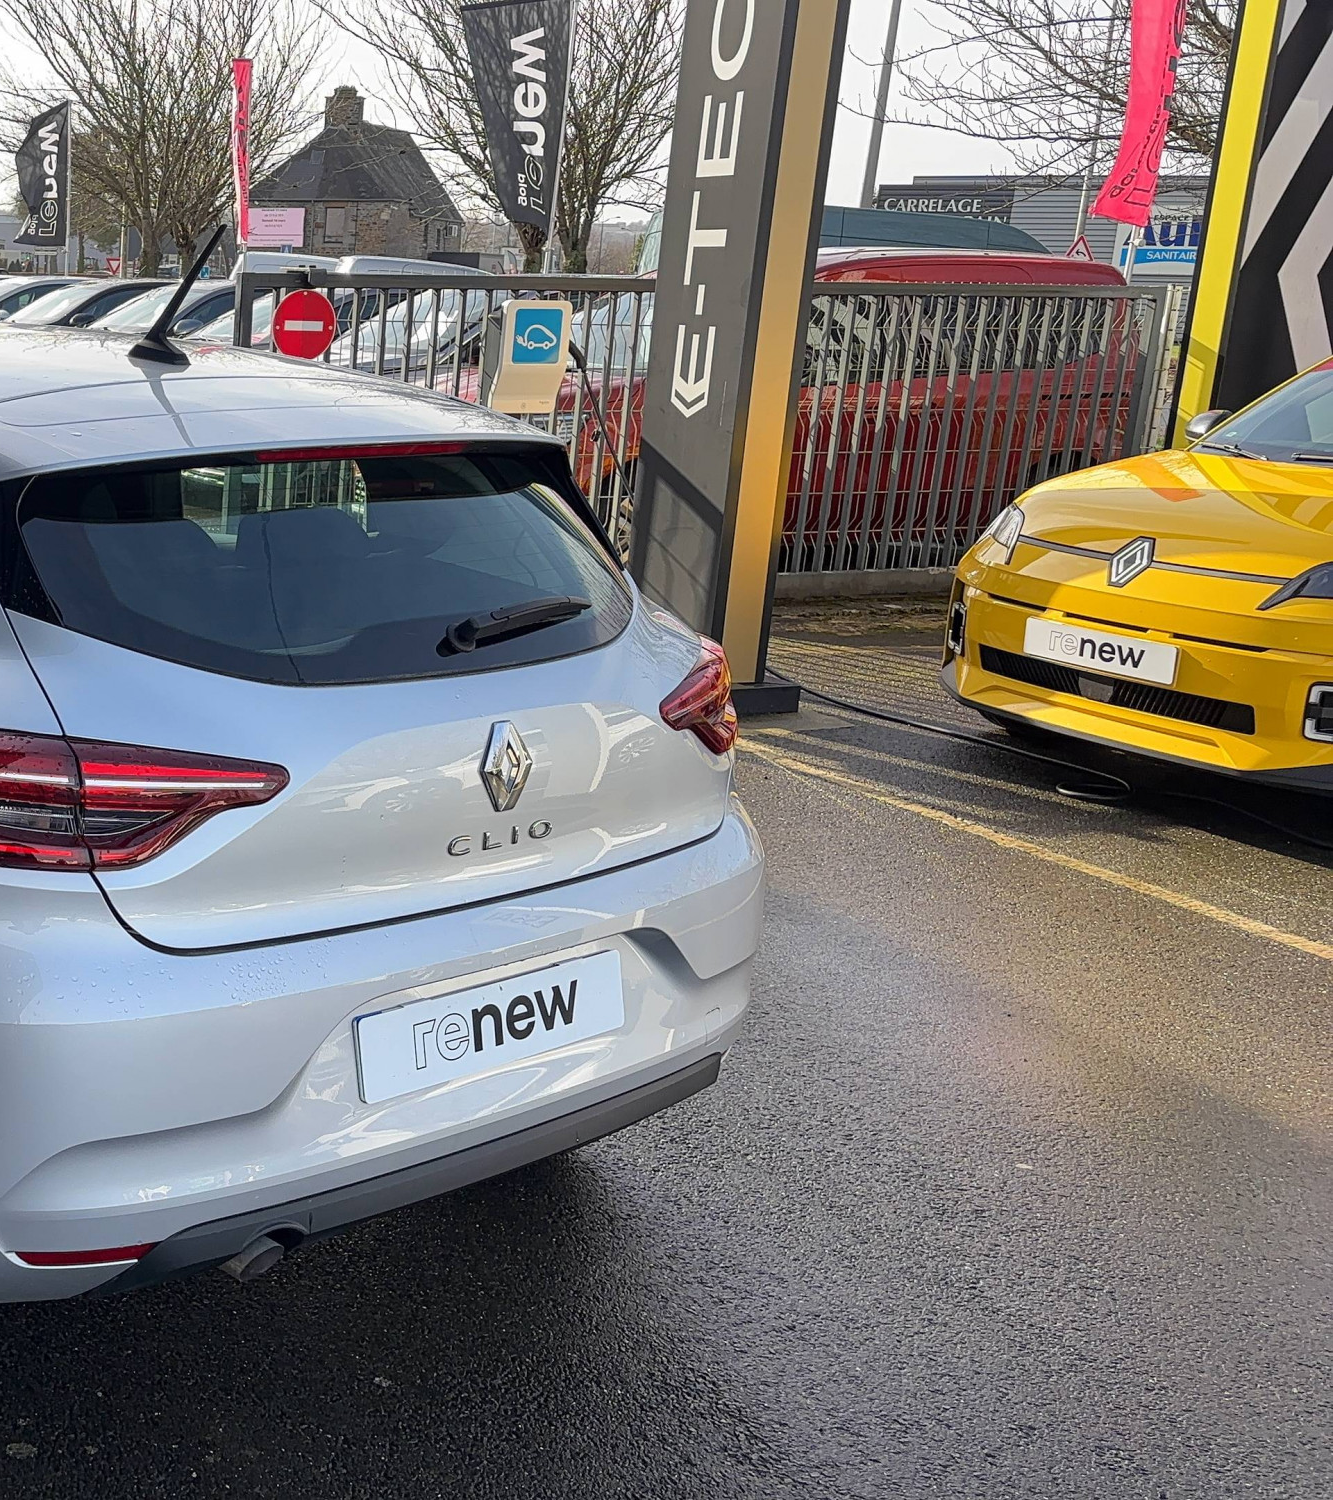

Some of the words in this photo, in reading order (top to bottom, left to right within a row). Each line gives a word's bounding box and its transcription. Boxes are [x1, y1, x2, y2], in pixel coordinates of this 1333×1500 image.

[884, 198, 982, 213] CARRELAGE
[1048, 630, 1145, 669] renew
[447, 818, 553, 857] CLIO
[412, 979, 578, 1070] renew
